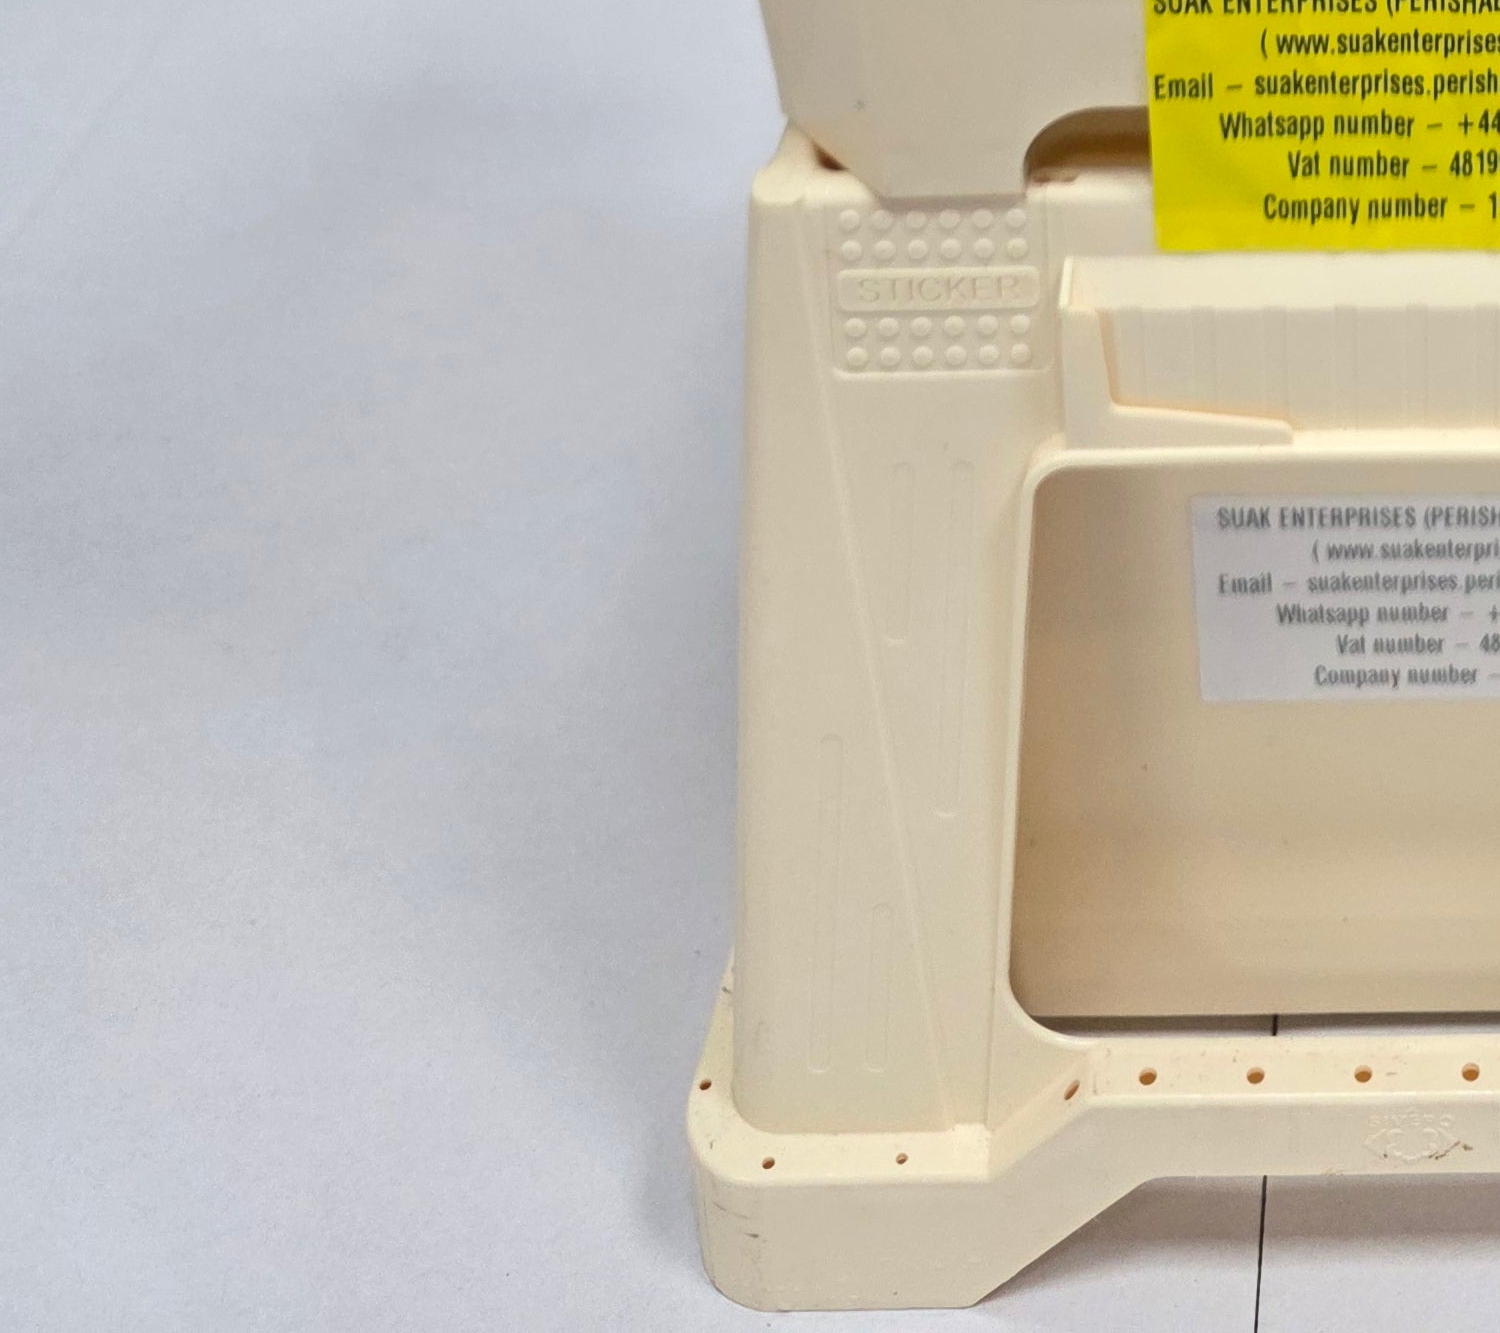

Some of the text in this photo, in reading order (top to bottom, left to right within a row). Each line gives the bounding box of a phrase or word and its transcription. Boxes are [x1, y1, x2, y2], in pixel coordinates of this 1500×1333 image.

[1261, 29, 1267, 58] (
[1155, 73, 1213, 100] Email
[1220, 112, 1324, 141] Whatsapp
[1334, 109, 1414, 137] number
[1288, 151, 1319, 179] Vat
[1330, 150, 1409, 178] number
[1264, 194, 1359, 225] Company
[1368, 193, 1447, 220] number
[856, 276, 1019, 302] STICKER
[1217, 507, 1270, 530] SUAK
[1280, 507, 1416, 530] ENTERPRISES
[1219, 573, 1272, 595] Email
[1277, 604, 1369, 627] Whatsapp
[1377, 602, 1448, 623] number
[1337, 635, 1365, 655] Vat
[1373, 633, 1444, 654] number
[1315, 665, 1400, 689] Company
[1408, 664, 1477, 685] number
